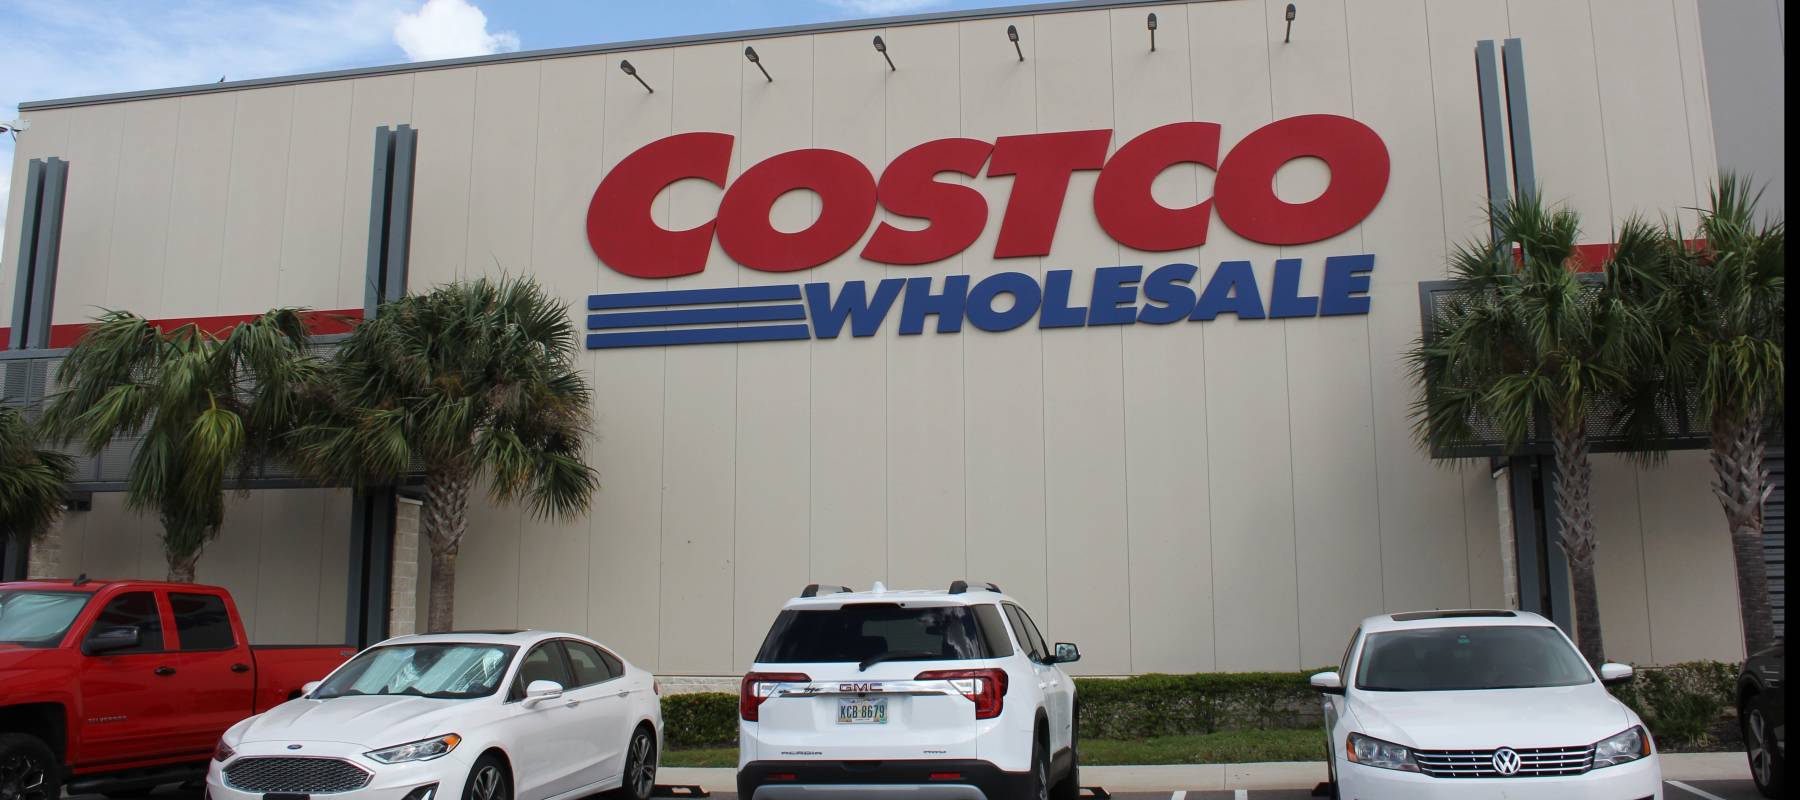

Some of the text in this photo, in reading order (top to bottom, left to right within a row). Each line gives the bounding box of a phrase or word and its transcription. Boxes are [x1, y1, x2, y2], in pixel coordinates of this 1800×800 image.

[587, 114, 1390, 278] COSTCO
[804, 254, 1376, 339] WHOLESALE
[839, 683, 883, 691] GMC
[840, 704, 885, 719] KCB 8679
